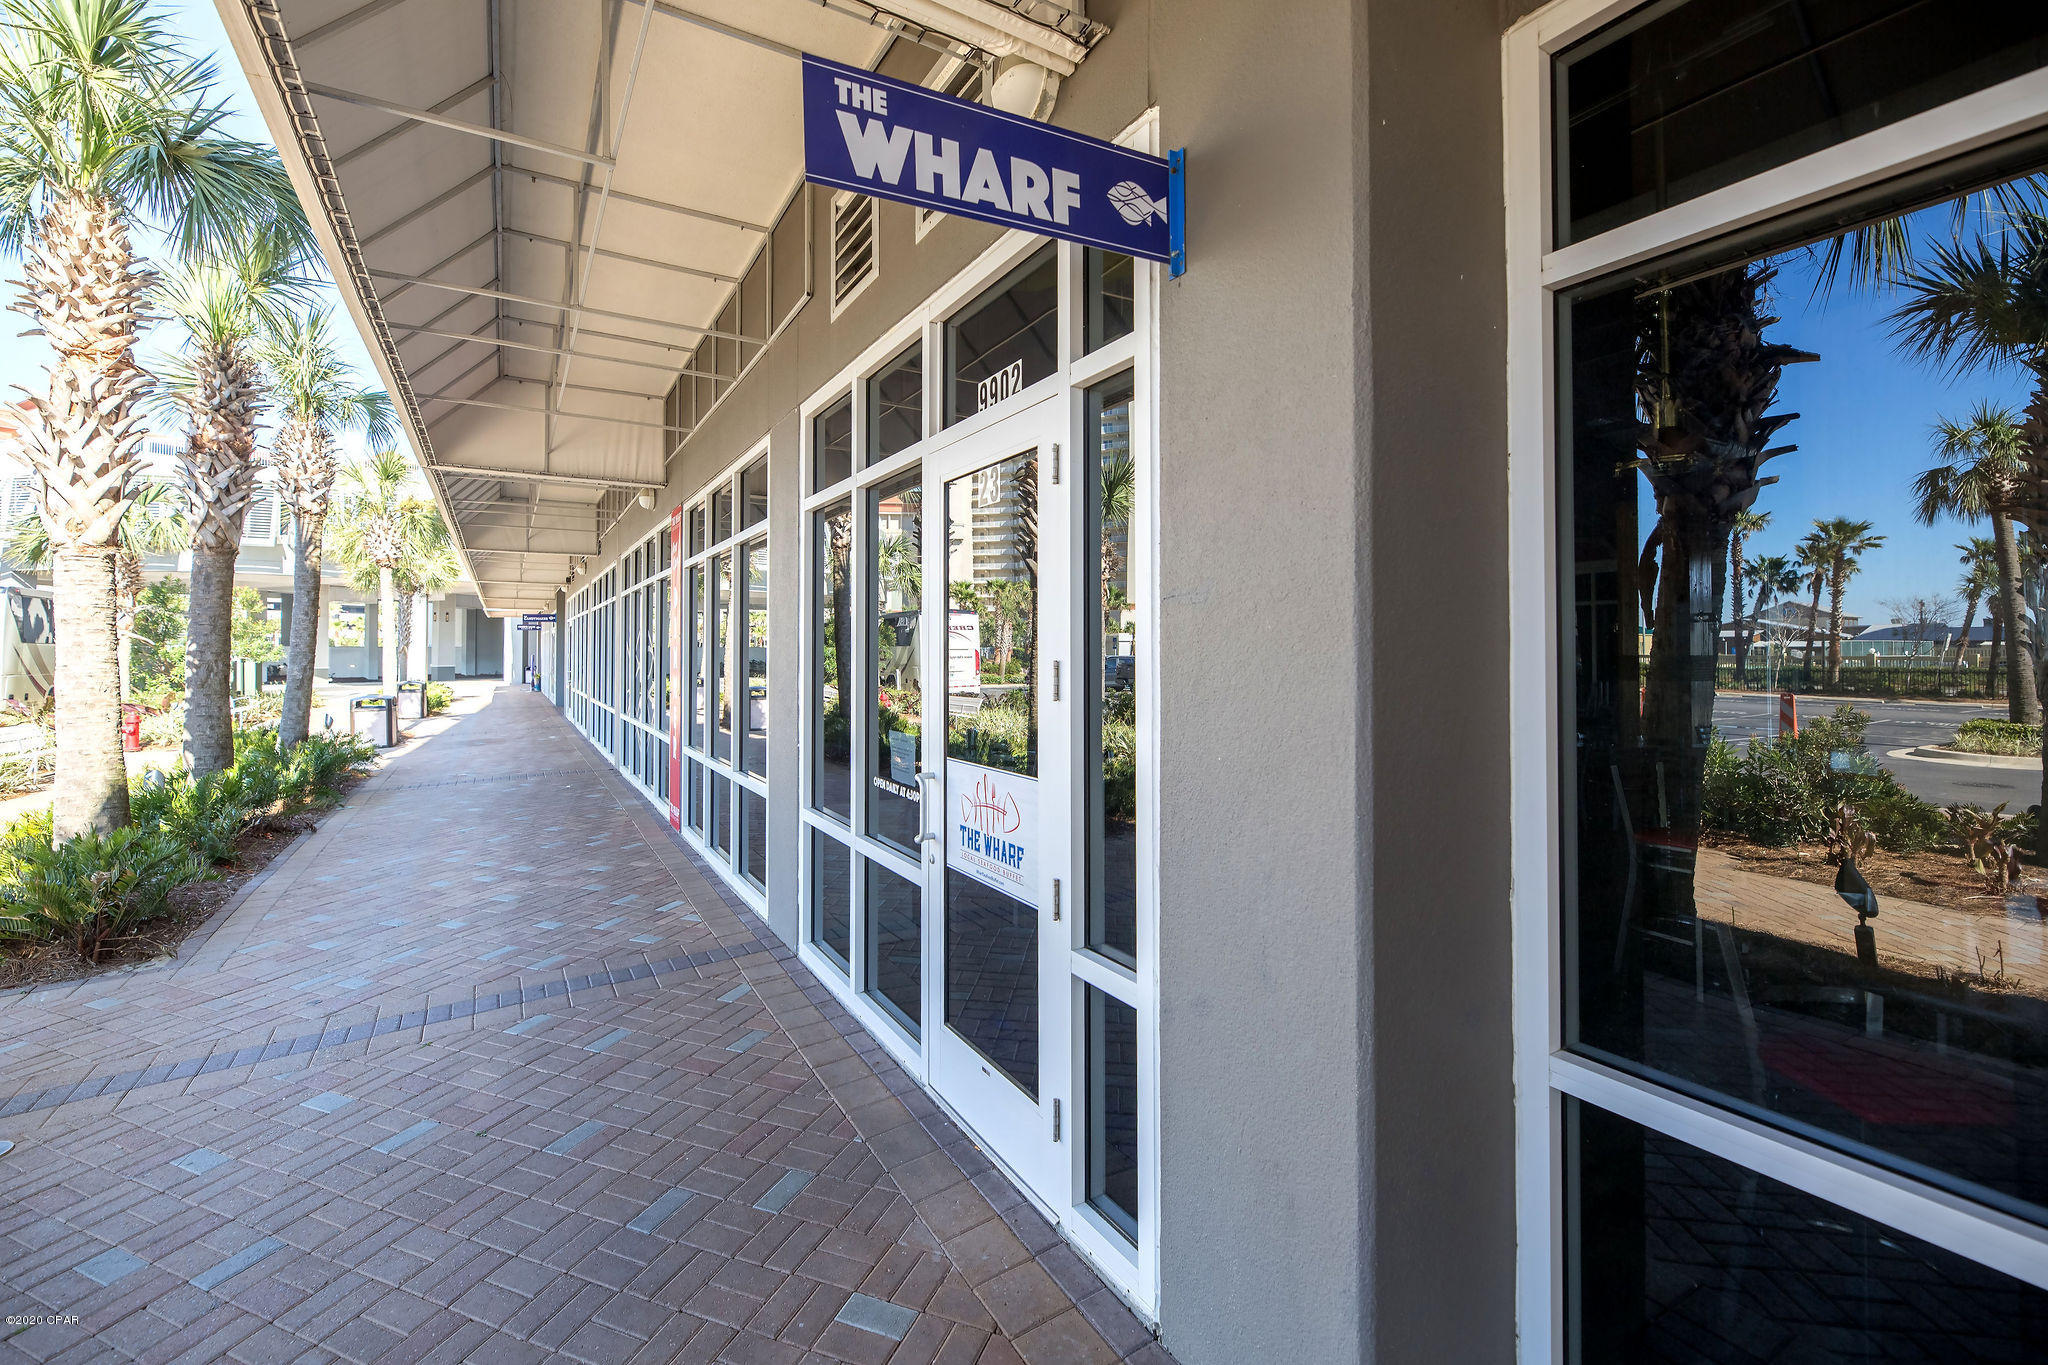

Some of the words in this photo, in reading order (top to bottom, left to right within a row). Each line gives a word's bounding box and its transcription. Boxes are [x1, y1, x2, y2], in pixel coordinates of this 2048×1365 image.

[834, 77, 888, 116] THE
[835, 109, 1081, 226] WHARF
[979, 363, 1021, 412] 9902
[979, 466, 999, 506] 23
[873, 776, 886, 790] OPEN
[886, 781, 899, 795] DAILY
[899, 786, 906, 798] AT
[960, 825, 981, 854] THE
[984, 832, 1025, 871] WHARF
[962, 851, 976, 863] LOCAL
[977, 858, 1001, 873] SEAFOOD
[1002, 869, 1022, 882] BUFFET
